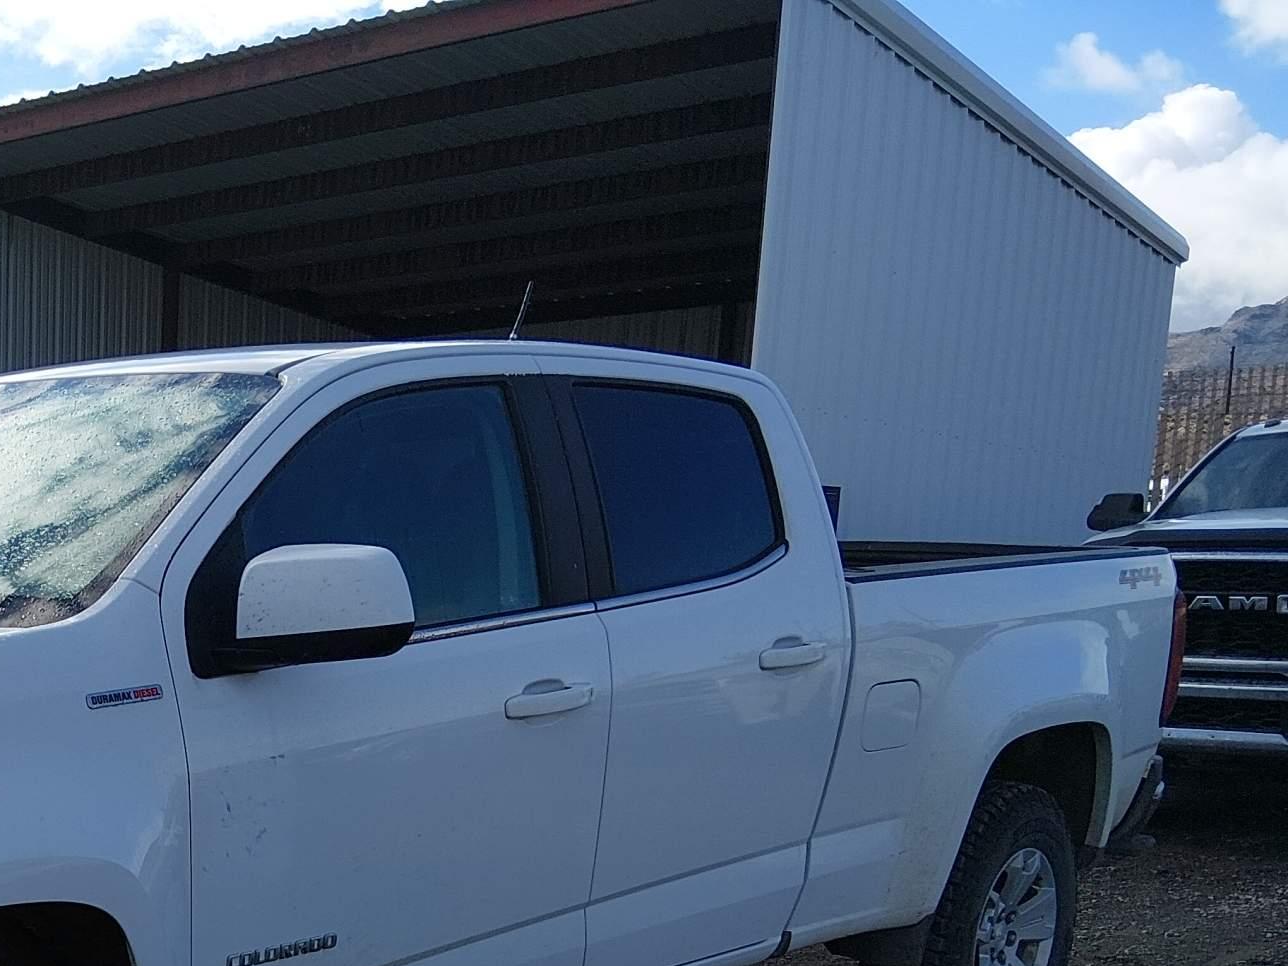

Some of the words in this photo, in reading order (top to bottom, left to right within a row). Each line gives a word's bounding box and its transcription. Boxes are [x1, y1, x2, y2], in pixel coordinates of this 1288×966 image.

[1188, 595, 1268, 610] AM
[91, 691, 132, 705] DURAMAX
[133, 687, 161, 699] DIESEL
